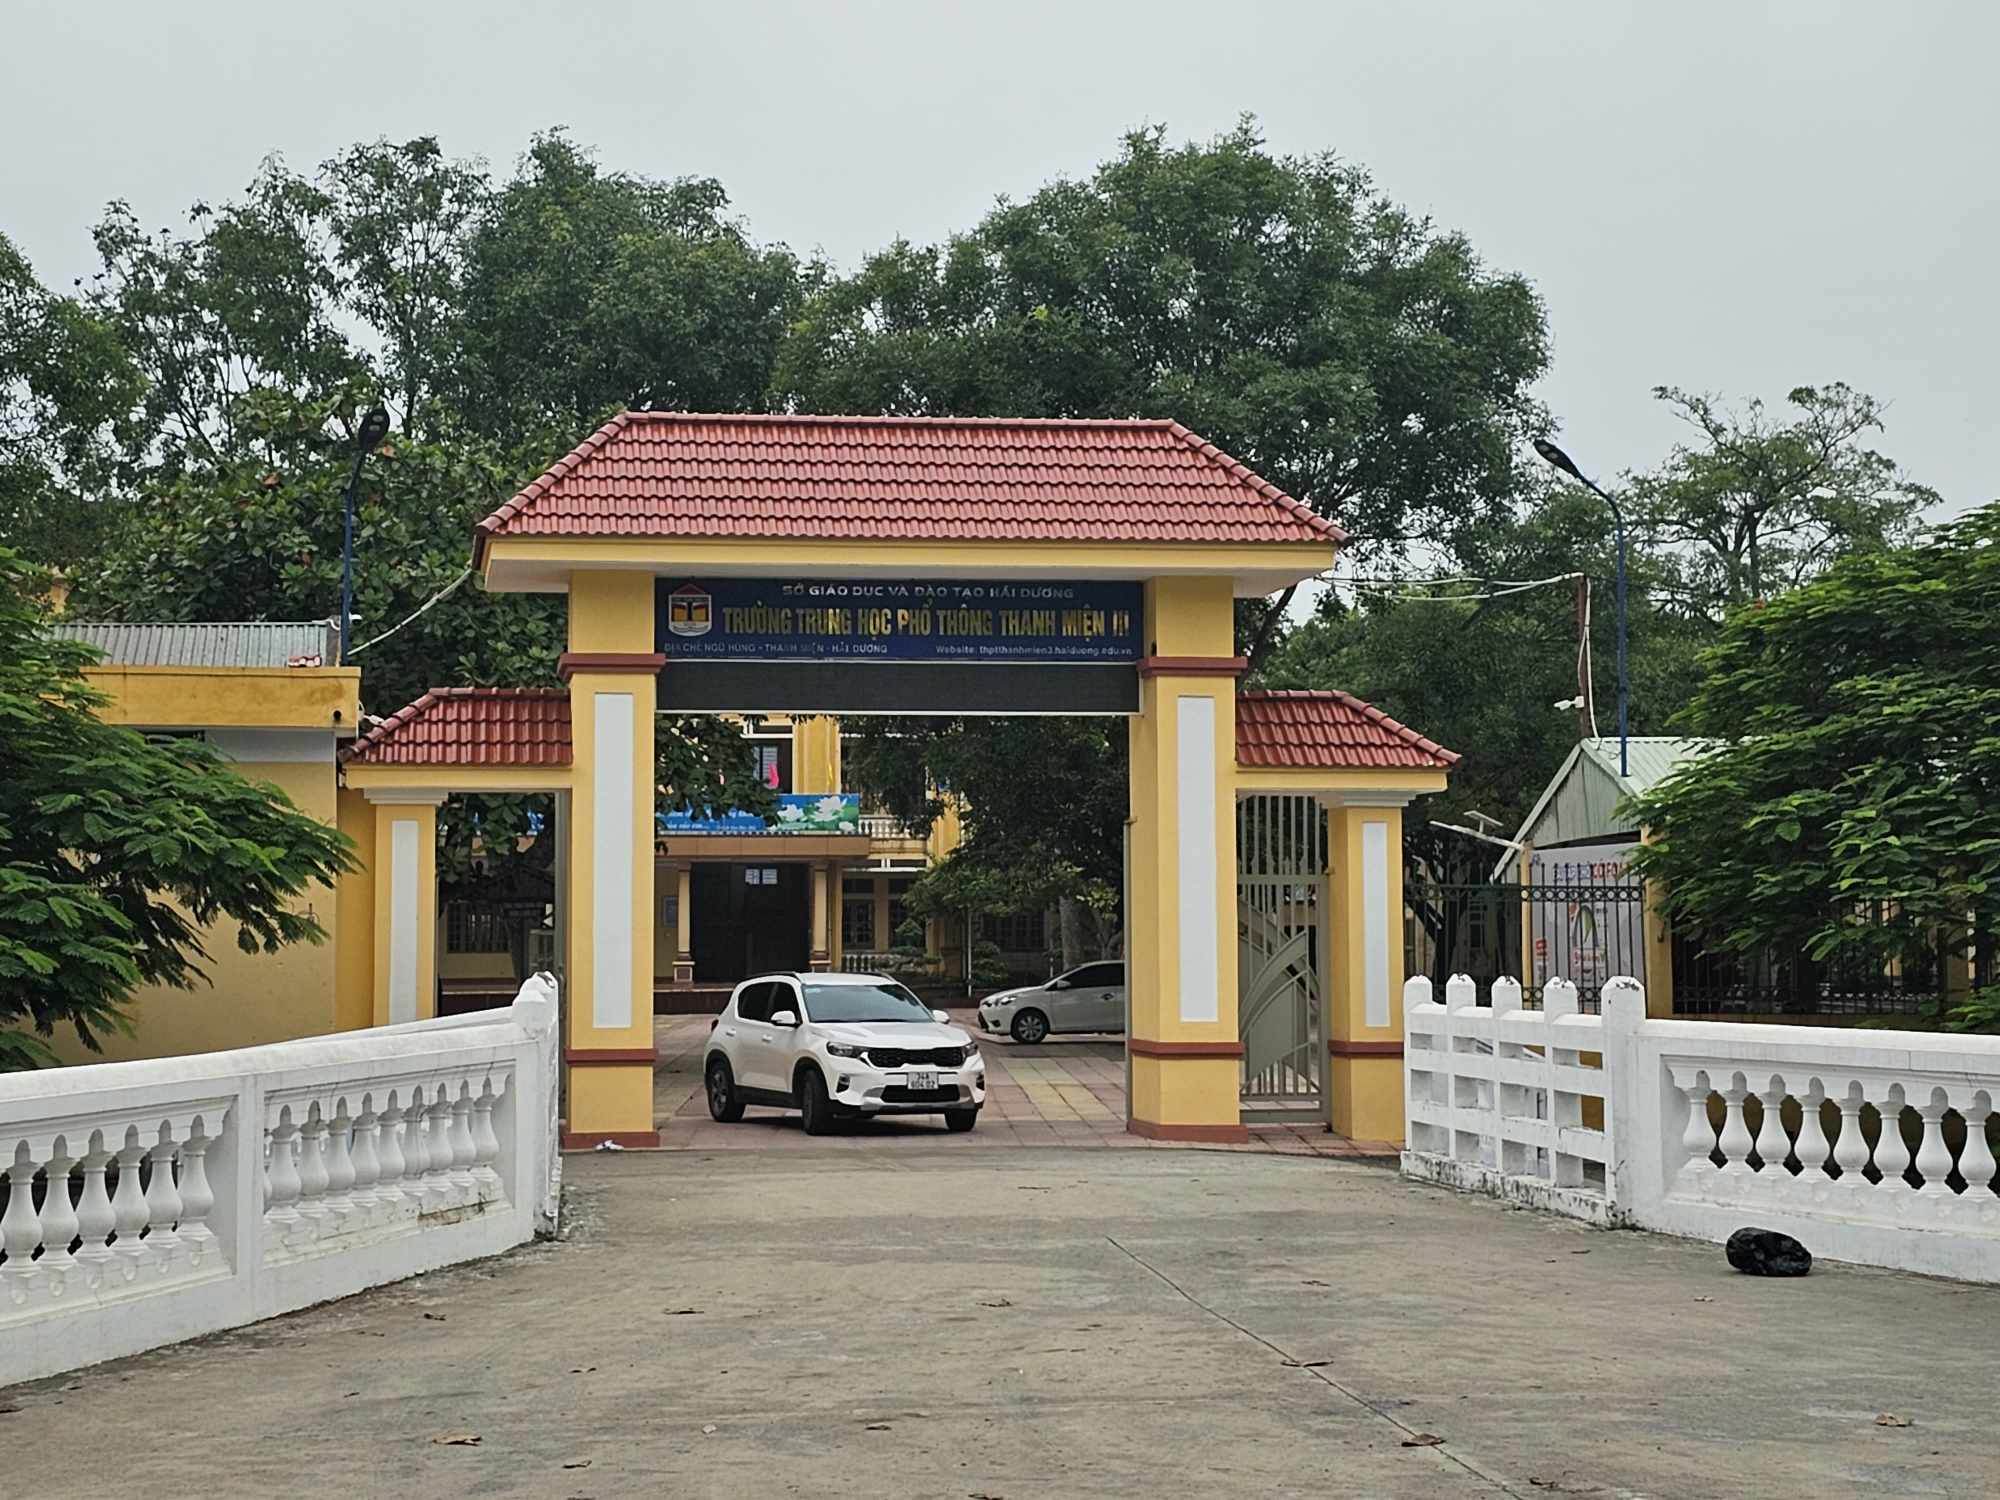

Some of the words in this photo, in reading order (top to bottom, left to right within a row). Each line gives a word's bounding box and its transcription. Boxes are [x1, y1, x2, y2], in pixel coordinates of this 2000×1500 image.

[808, 583, 848, 596] GIÁO
[951, 586, 985, 600] TẠO
[722, 600, 792, 634] TRƯỜNG
[796, 608, 853, 635] TRUNG
[858, 608, 892, 641] HỌC
[897, 598, 933, 635] PHỔ
[936, 603, 993, 636] THÔNG
[999, 610, 1056, 636] THANH
[1062, 603, 1105, 642] MIỆN
